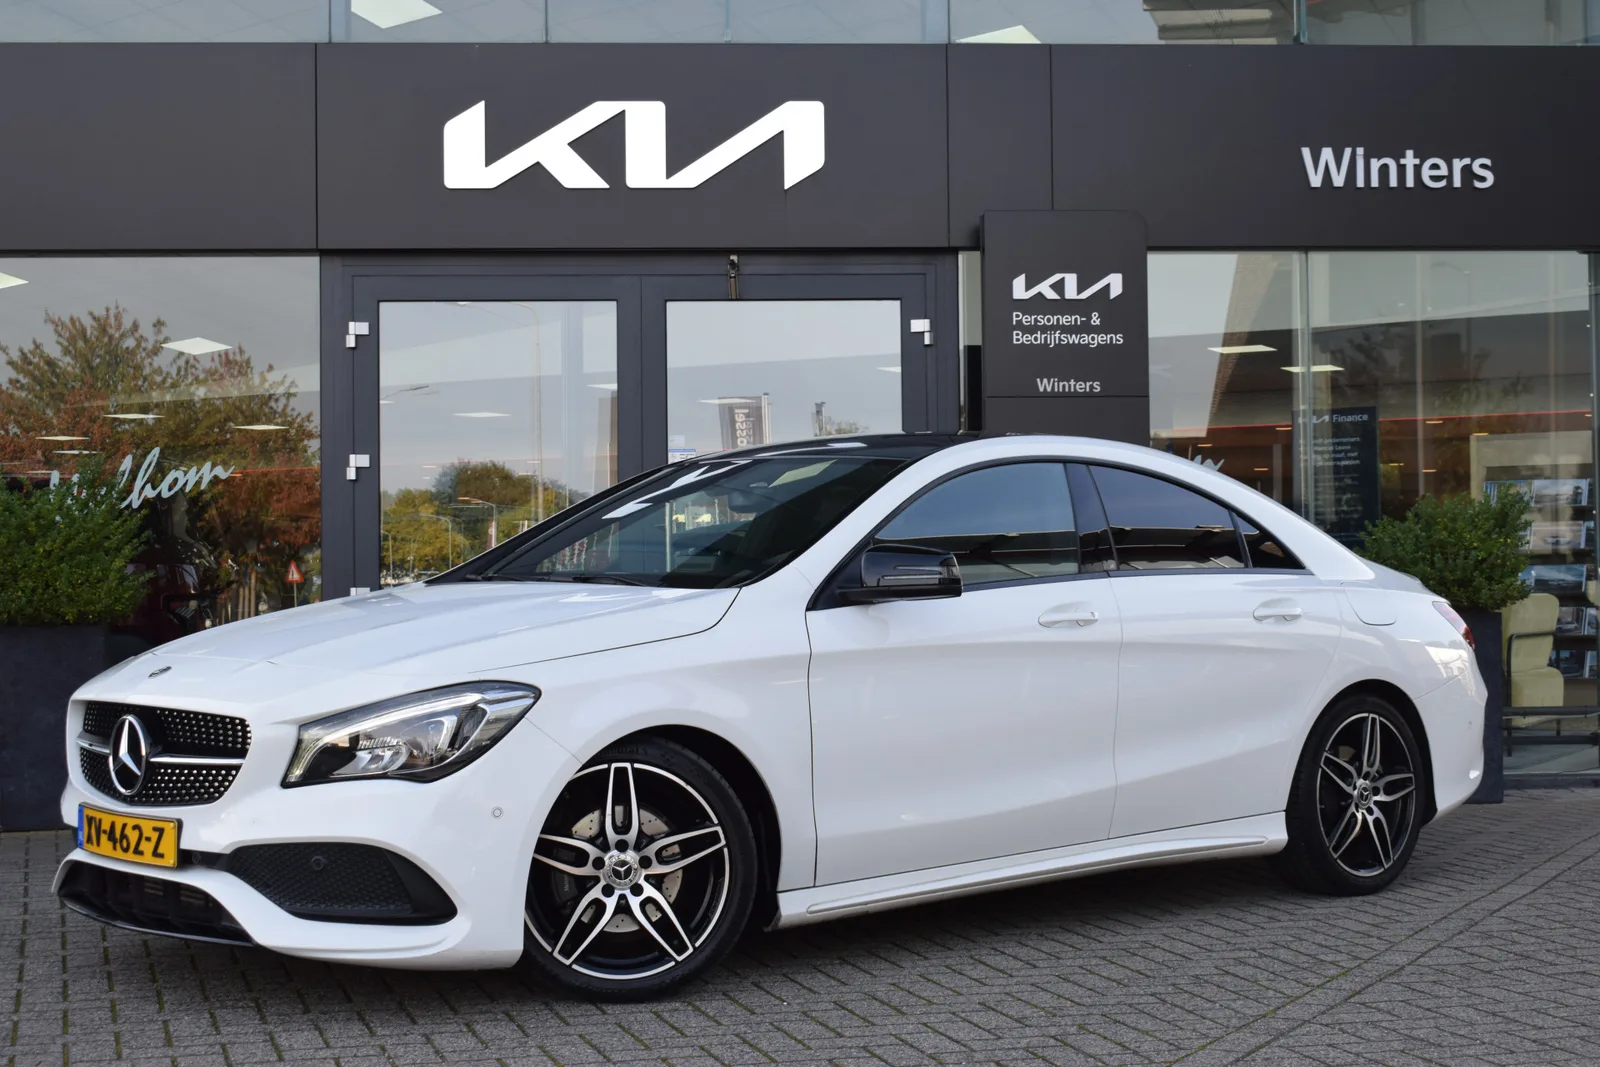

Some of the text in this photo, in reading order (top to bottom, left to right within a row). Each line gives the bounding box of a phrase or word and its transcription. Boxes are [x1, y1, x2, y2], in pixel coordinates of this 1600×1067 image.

[443, 100, 826, 190] KIA
[1300, 146, 1495, 190] Winters
[1012, 272, 1123, 300] KIA
[1012, 311, 1101, 326] Personen- &
[1012, 329, 1124, 348] Bedrijfswagens
[1036, 377, 1101, 393] Winters
[1332, 413, 1369, 423] Finance
[85, 814, 165, 859] XV-462-Z
